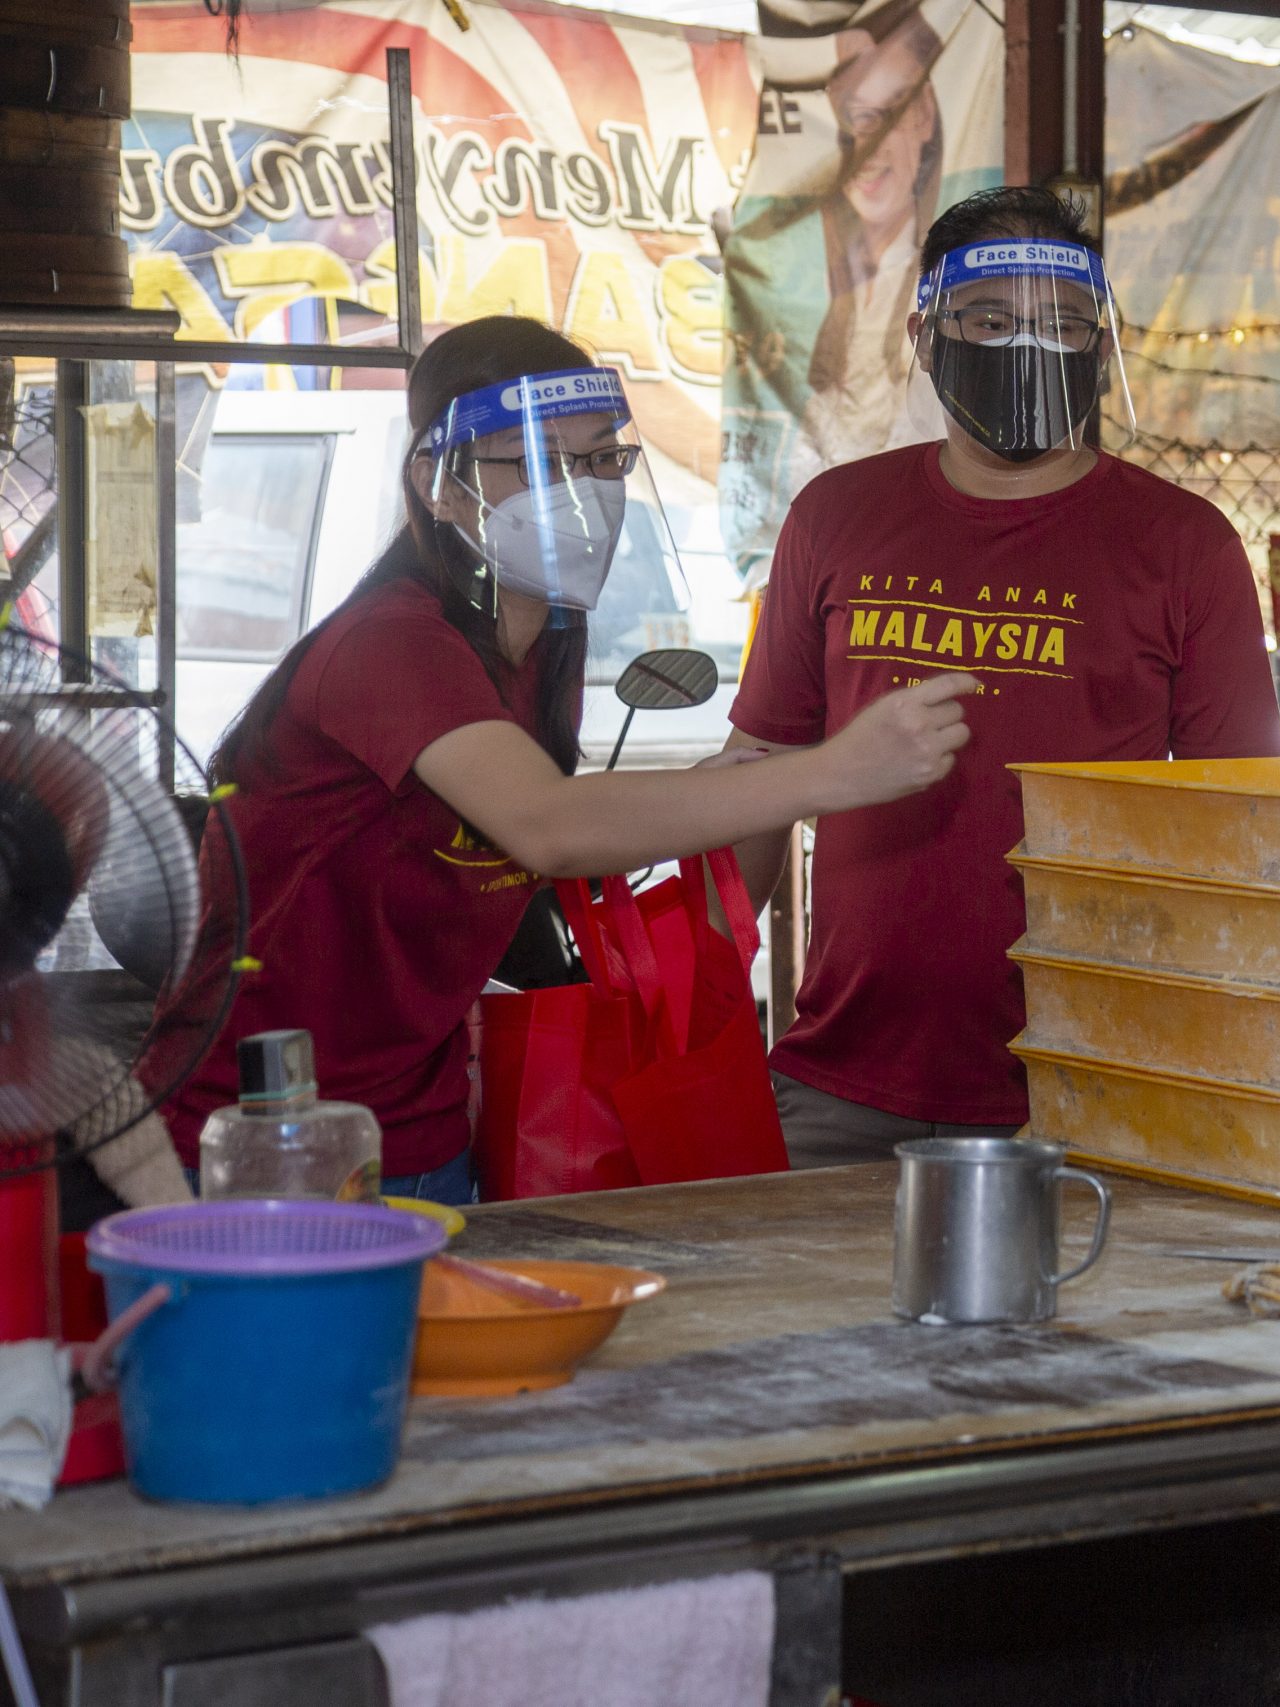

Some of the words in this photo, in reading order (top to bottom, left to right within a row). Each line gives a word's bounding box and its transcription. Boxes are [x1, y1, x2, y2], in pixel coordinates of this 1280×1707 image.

[976, 249, 1017, 263] Face
[1025, 246, 1080, 265] Shield
[981, 267, 1006, 276] Direct
[1007, 266, 1035, 275] Splash
[1036, 266, 1076, 278] Protection
[516, 384, 567, 403] Face
[574, 377, 621, 394] Shield
[530, 406, 557, 418] Direct
[558, 399, 588, 413] Splash
[860, 575, 943, 594] KITA
[977, 585, 1078, 609] ANAK
[850, 609, 1065, 666] MALAYSIA
